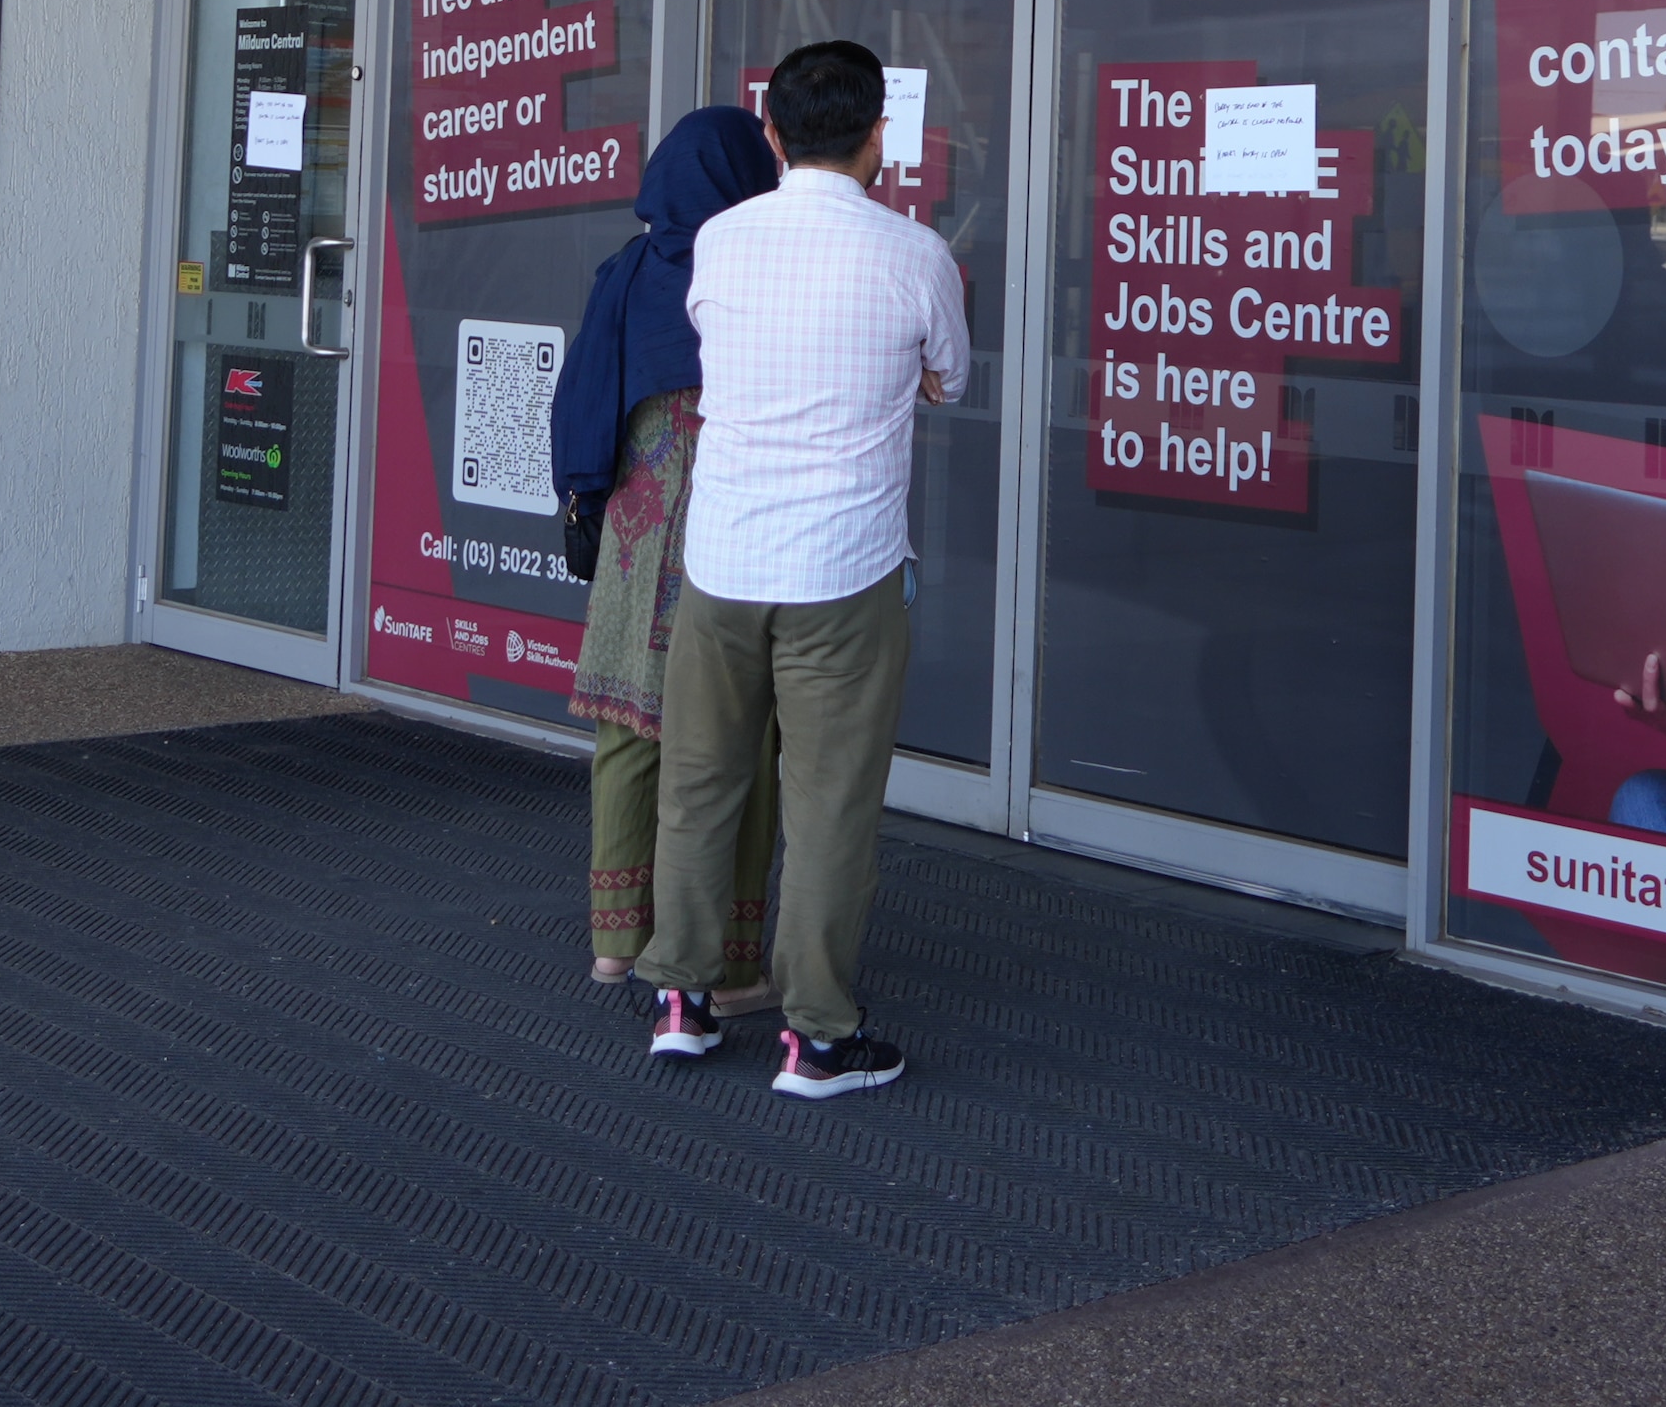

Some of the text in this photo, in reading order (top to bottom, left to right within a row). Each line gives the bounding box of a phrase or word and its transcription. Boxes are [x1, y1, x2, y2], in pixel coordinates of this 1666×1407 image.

[238, 32, 304, 50] Mildura Central
[239, 19, 267, 28] Welcome to
[422, 11, 596, 79] independent
[422, 93, 546, 140] career or
[1111, 79, 1193, 128] The
[423, 138, 621, 206] study advice?
[1109, 146, 1339, 199] SuniE
[1107, 213, 1332, 271] Skills and
[1105, 281, 1390, 347] Jobs Centre
[1103, 349, 1256, 409] is here
[222, 443, 266, 463] Woolworths
[1101, 418, 1271, 492] to help!
[221, 469, 251, 480] Opening Hours
[420, 532, 588, 585] Call: (03) 5022 39
[384, 615, 432, 643] SuniTAFE
[454, 630, 489, 646] AND JOBS
[455, 618, 477, 632] SKILLS
[454, 640, 486, 657] CENTRES
[526, 650, 578, 674] Skills Authority
[527, 639, 558, 655] Victorian
